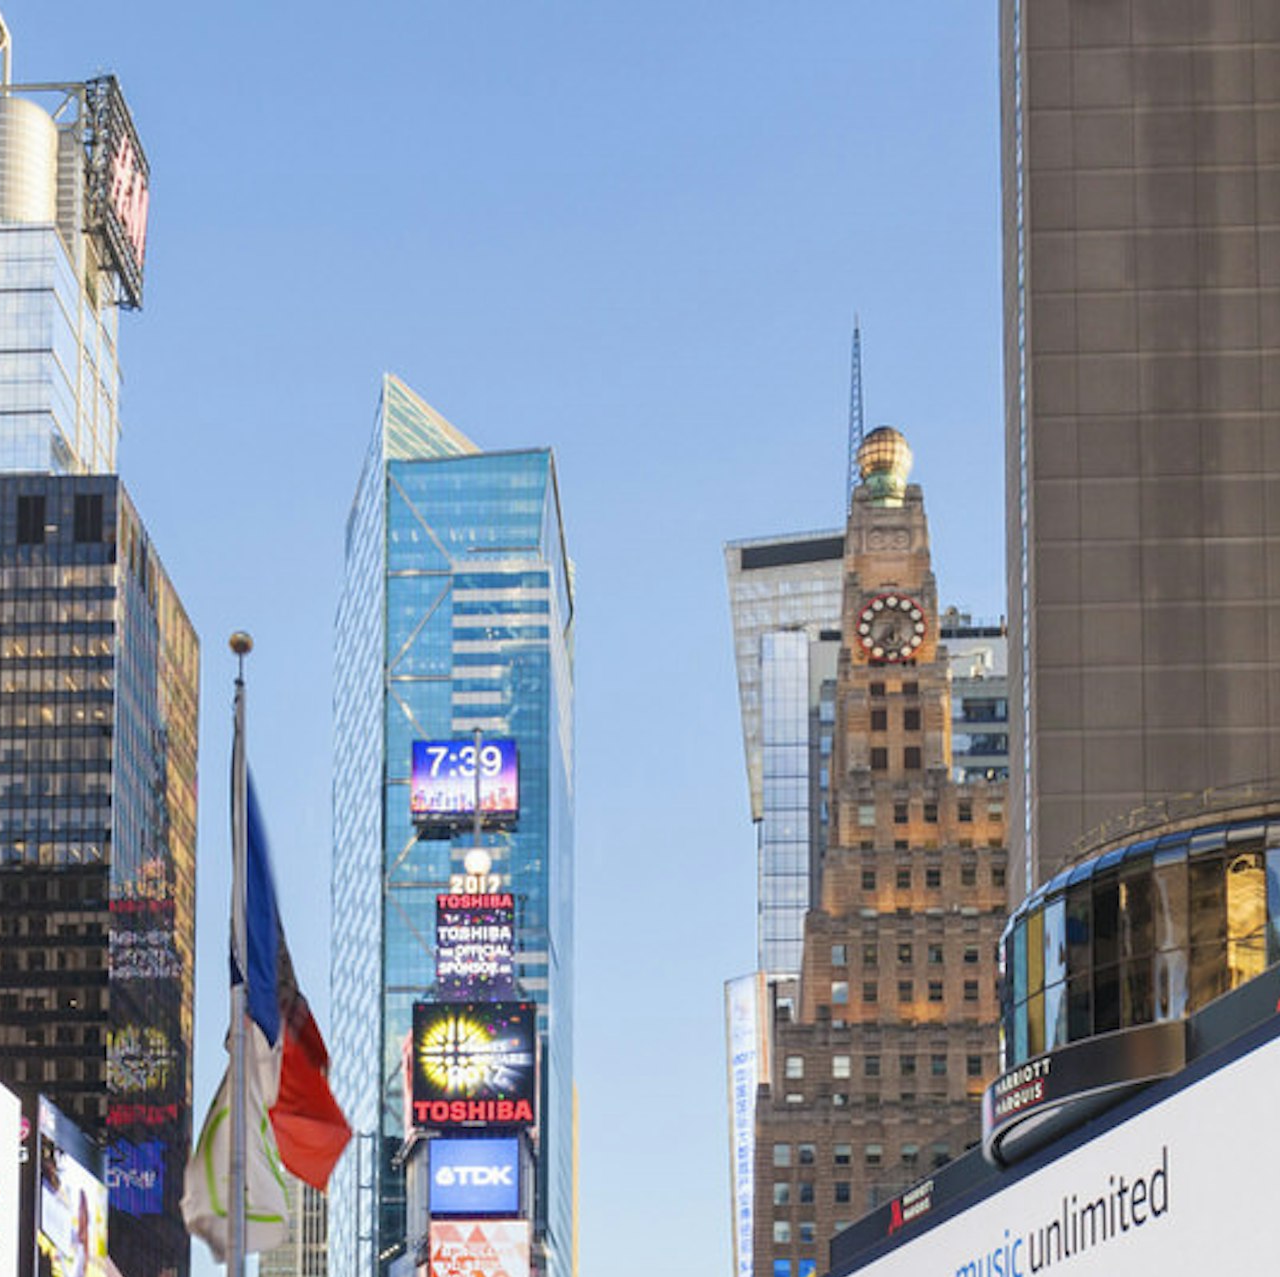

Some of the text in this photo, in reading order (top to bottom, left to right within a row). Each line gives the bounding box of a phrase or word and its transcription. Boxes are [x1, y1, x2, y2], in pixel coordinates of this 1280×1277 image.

[426, 746, 502, 777] 7:39
[450, 874, 500, 894] 2017
[437, 894, 513, 909] TOSHIBA
[438, 926, 512, 940] TOSHIBA
[994, 1057, 1052, 1096] MARRIOTT
[414, 1099, 534, 1123] TOSHIBA
[453, 1167, 514, 1186] TDK
[1028, 1145, 1170, 1275] unlimited
